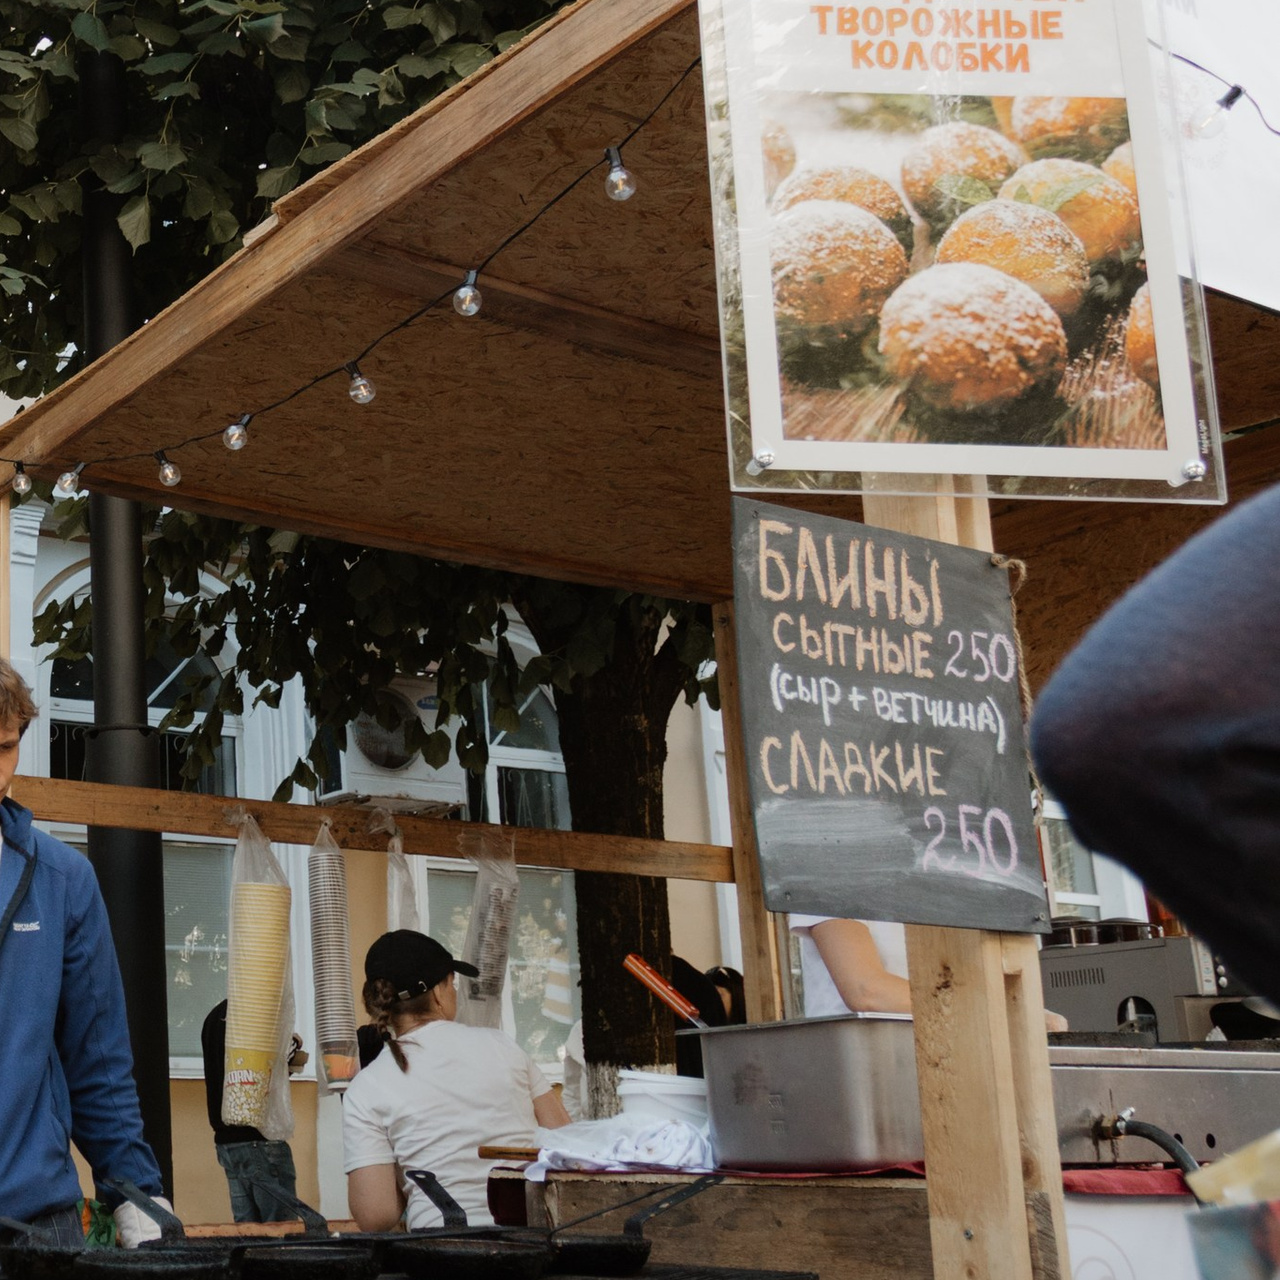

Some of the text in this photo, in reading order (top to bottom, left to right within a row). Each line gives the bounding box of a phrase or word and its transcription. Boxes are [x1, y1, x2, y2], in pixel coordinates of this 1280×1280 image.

[809, 5, 1064, 40] ТВОРОЖНЫЕ
[851, 39, 1031, 73] КОЛОБКИ
[758, 519, 944, 626] БЛИНЫ
[773, 612, 1017, 682] СЫТНЫЕ 250
[872, 686, 1006, 755] ВЕТЧИНА)
[760, 730, 948, 796] СЛАДКИЕ
[922, 804, 1019, 878] 250
